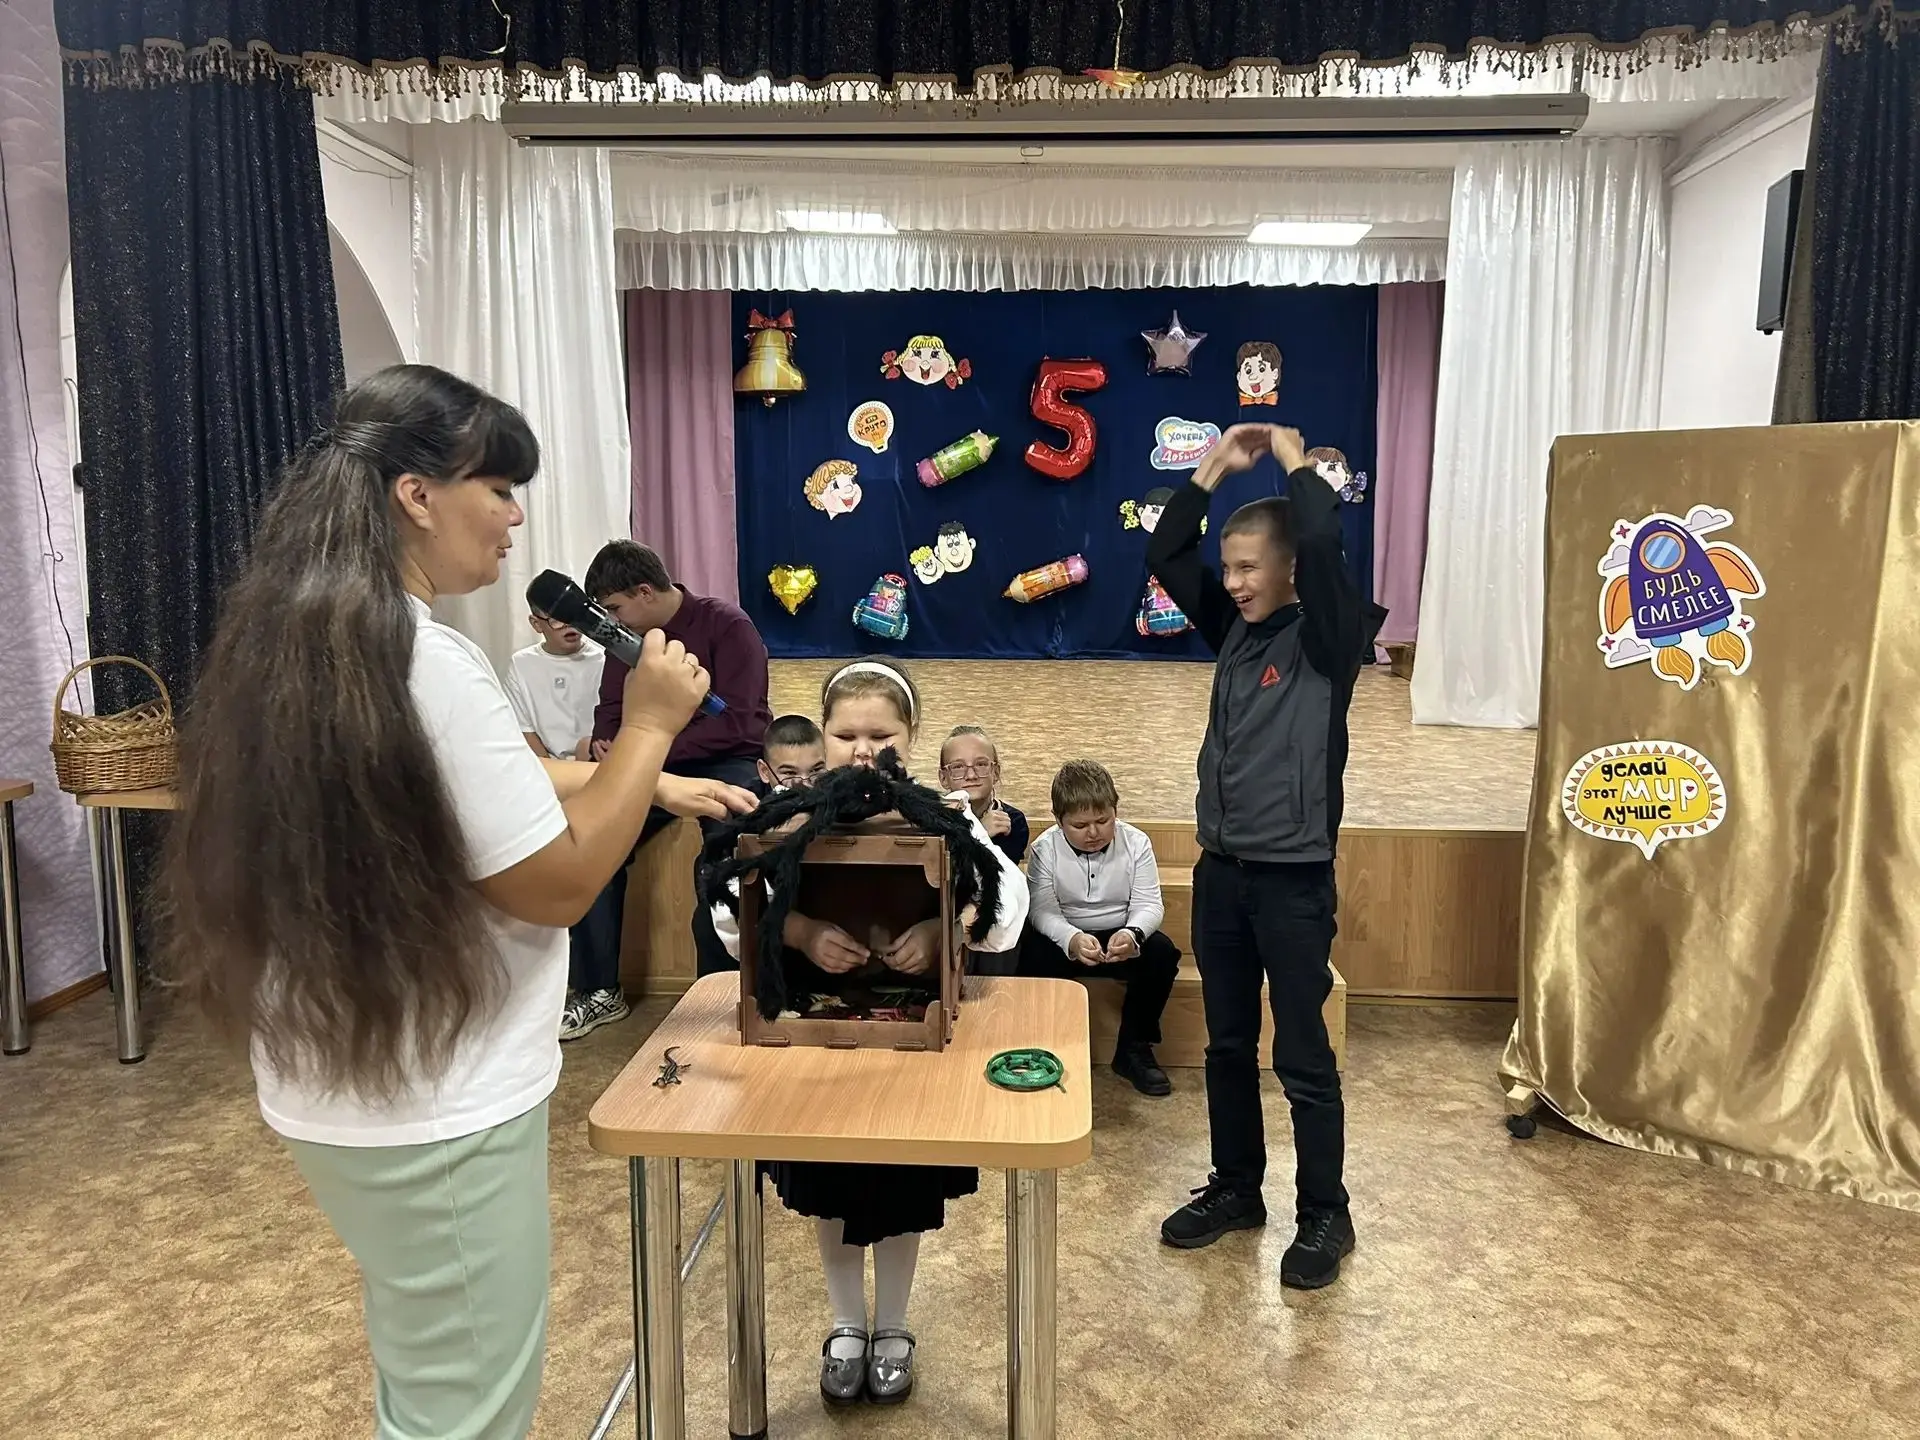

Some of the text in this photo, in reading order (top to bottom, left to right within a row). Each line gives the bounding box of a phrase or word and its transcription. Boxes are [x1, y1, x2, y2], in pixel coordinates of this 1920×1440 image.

[858, 420, 886, 436] КРУТО
[1025, 359, 1106, 479] 5
[1643, 569, 1702, 600] БУДЬ
[1638, 586, 1724, 625] СМЕЛЕЕ
[1601, 757, 1667, 782] делай
[1620, 777, 1699, 812] мир
[1603, 804, 1672, 825] лучше
